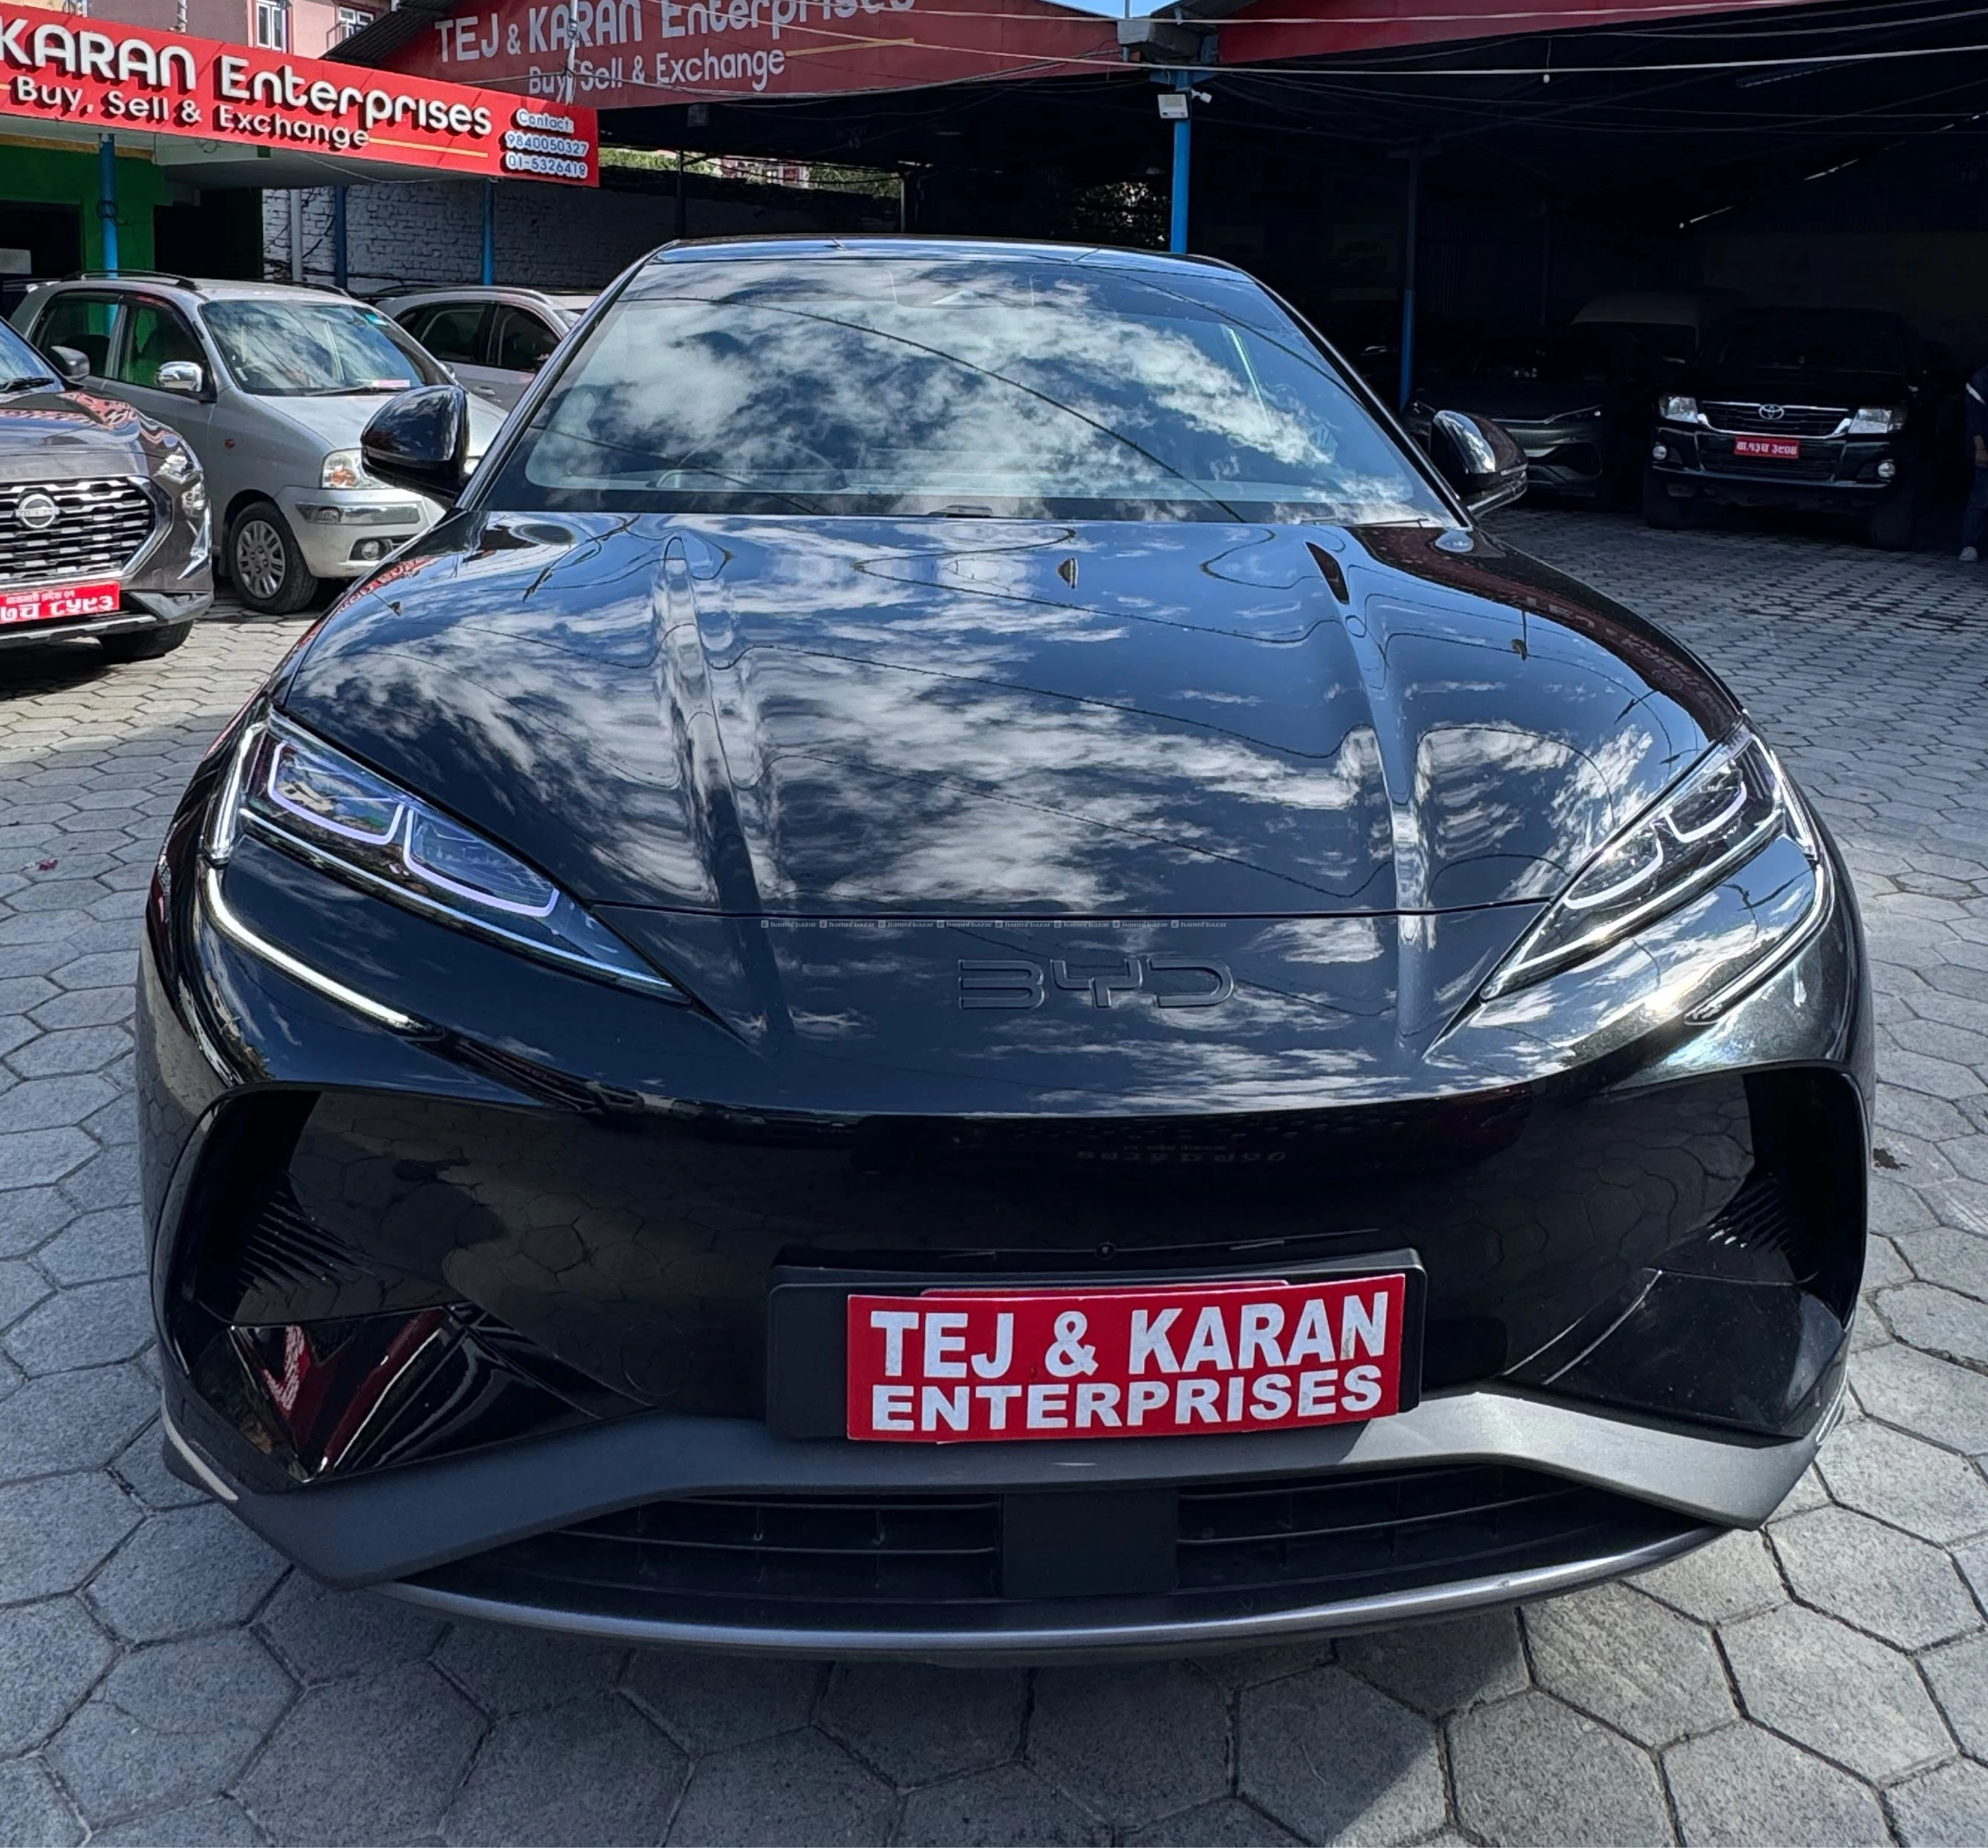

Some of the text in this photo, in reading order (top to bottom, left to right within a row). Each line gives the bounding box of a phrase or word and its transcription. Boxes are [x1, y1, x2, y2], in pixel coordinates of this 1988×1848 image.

[434, 13, 499, 62] TEJ
[507, 24, 521, 55] &
[529, 0, 642, 53] KARAN
[0, 15, 492, 135] KARAN Enterprises
[580, 56, 623, 91] Sell
[633, 55, 646, 84] &
[656, 48, 785, 92] Exchange
[17, 76, 370, 149] Buy, Sell & Exchange
[507, 133, 587, 155] 9840050327
[508, 154, 586, 176] 01-5326418
[958, 957, 1234, 1009] BYD
[870, 1291, 1388, 1379] TEJ & KARAN
[872, 1364, 1382, 1432] ENTERPRISES
